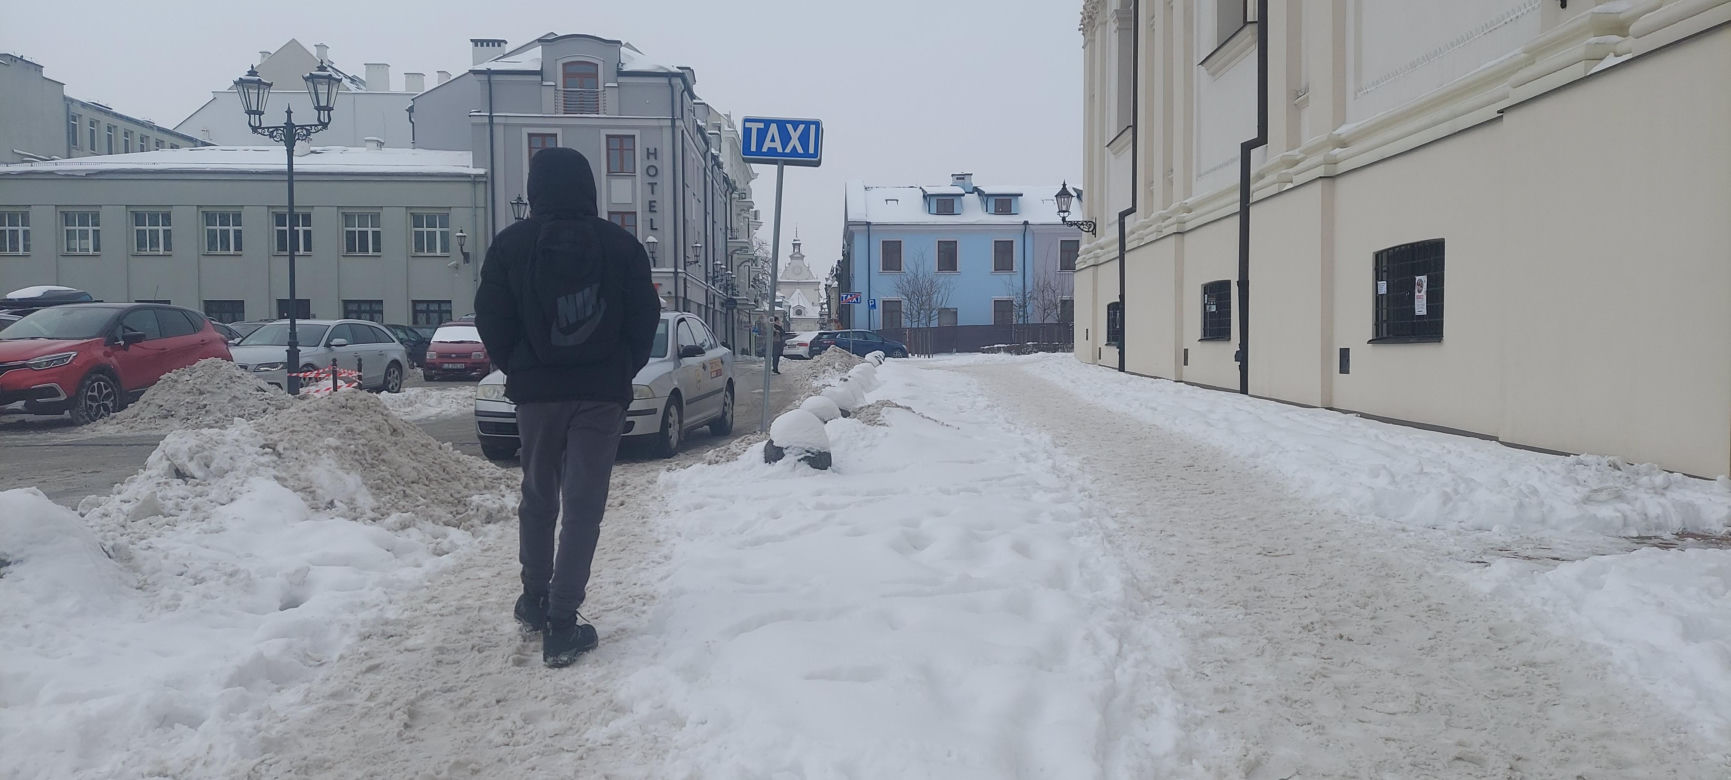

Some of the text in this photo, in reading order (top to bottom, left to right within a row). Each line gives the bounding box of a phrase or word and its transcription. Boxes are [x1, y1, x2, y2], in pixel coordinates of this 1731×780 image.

[745, 122, 816, 154] TAXI
[646, 147, 658, 231] HOTEL
[556, 283, 600, 328] NIK
[841, 294, 861, 303] TAXI
